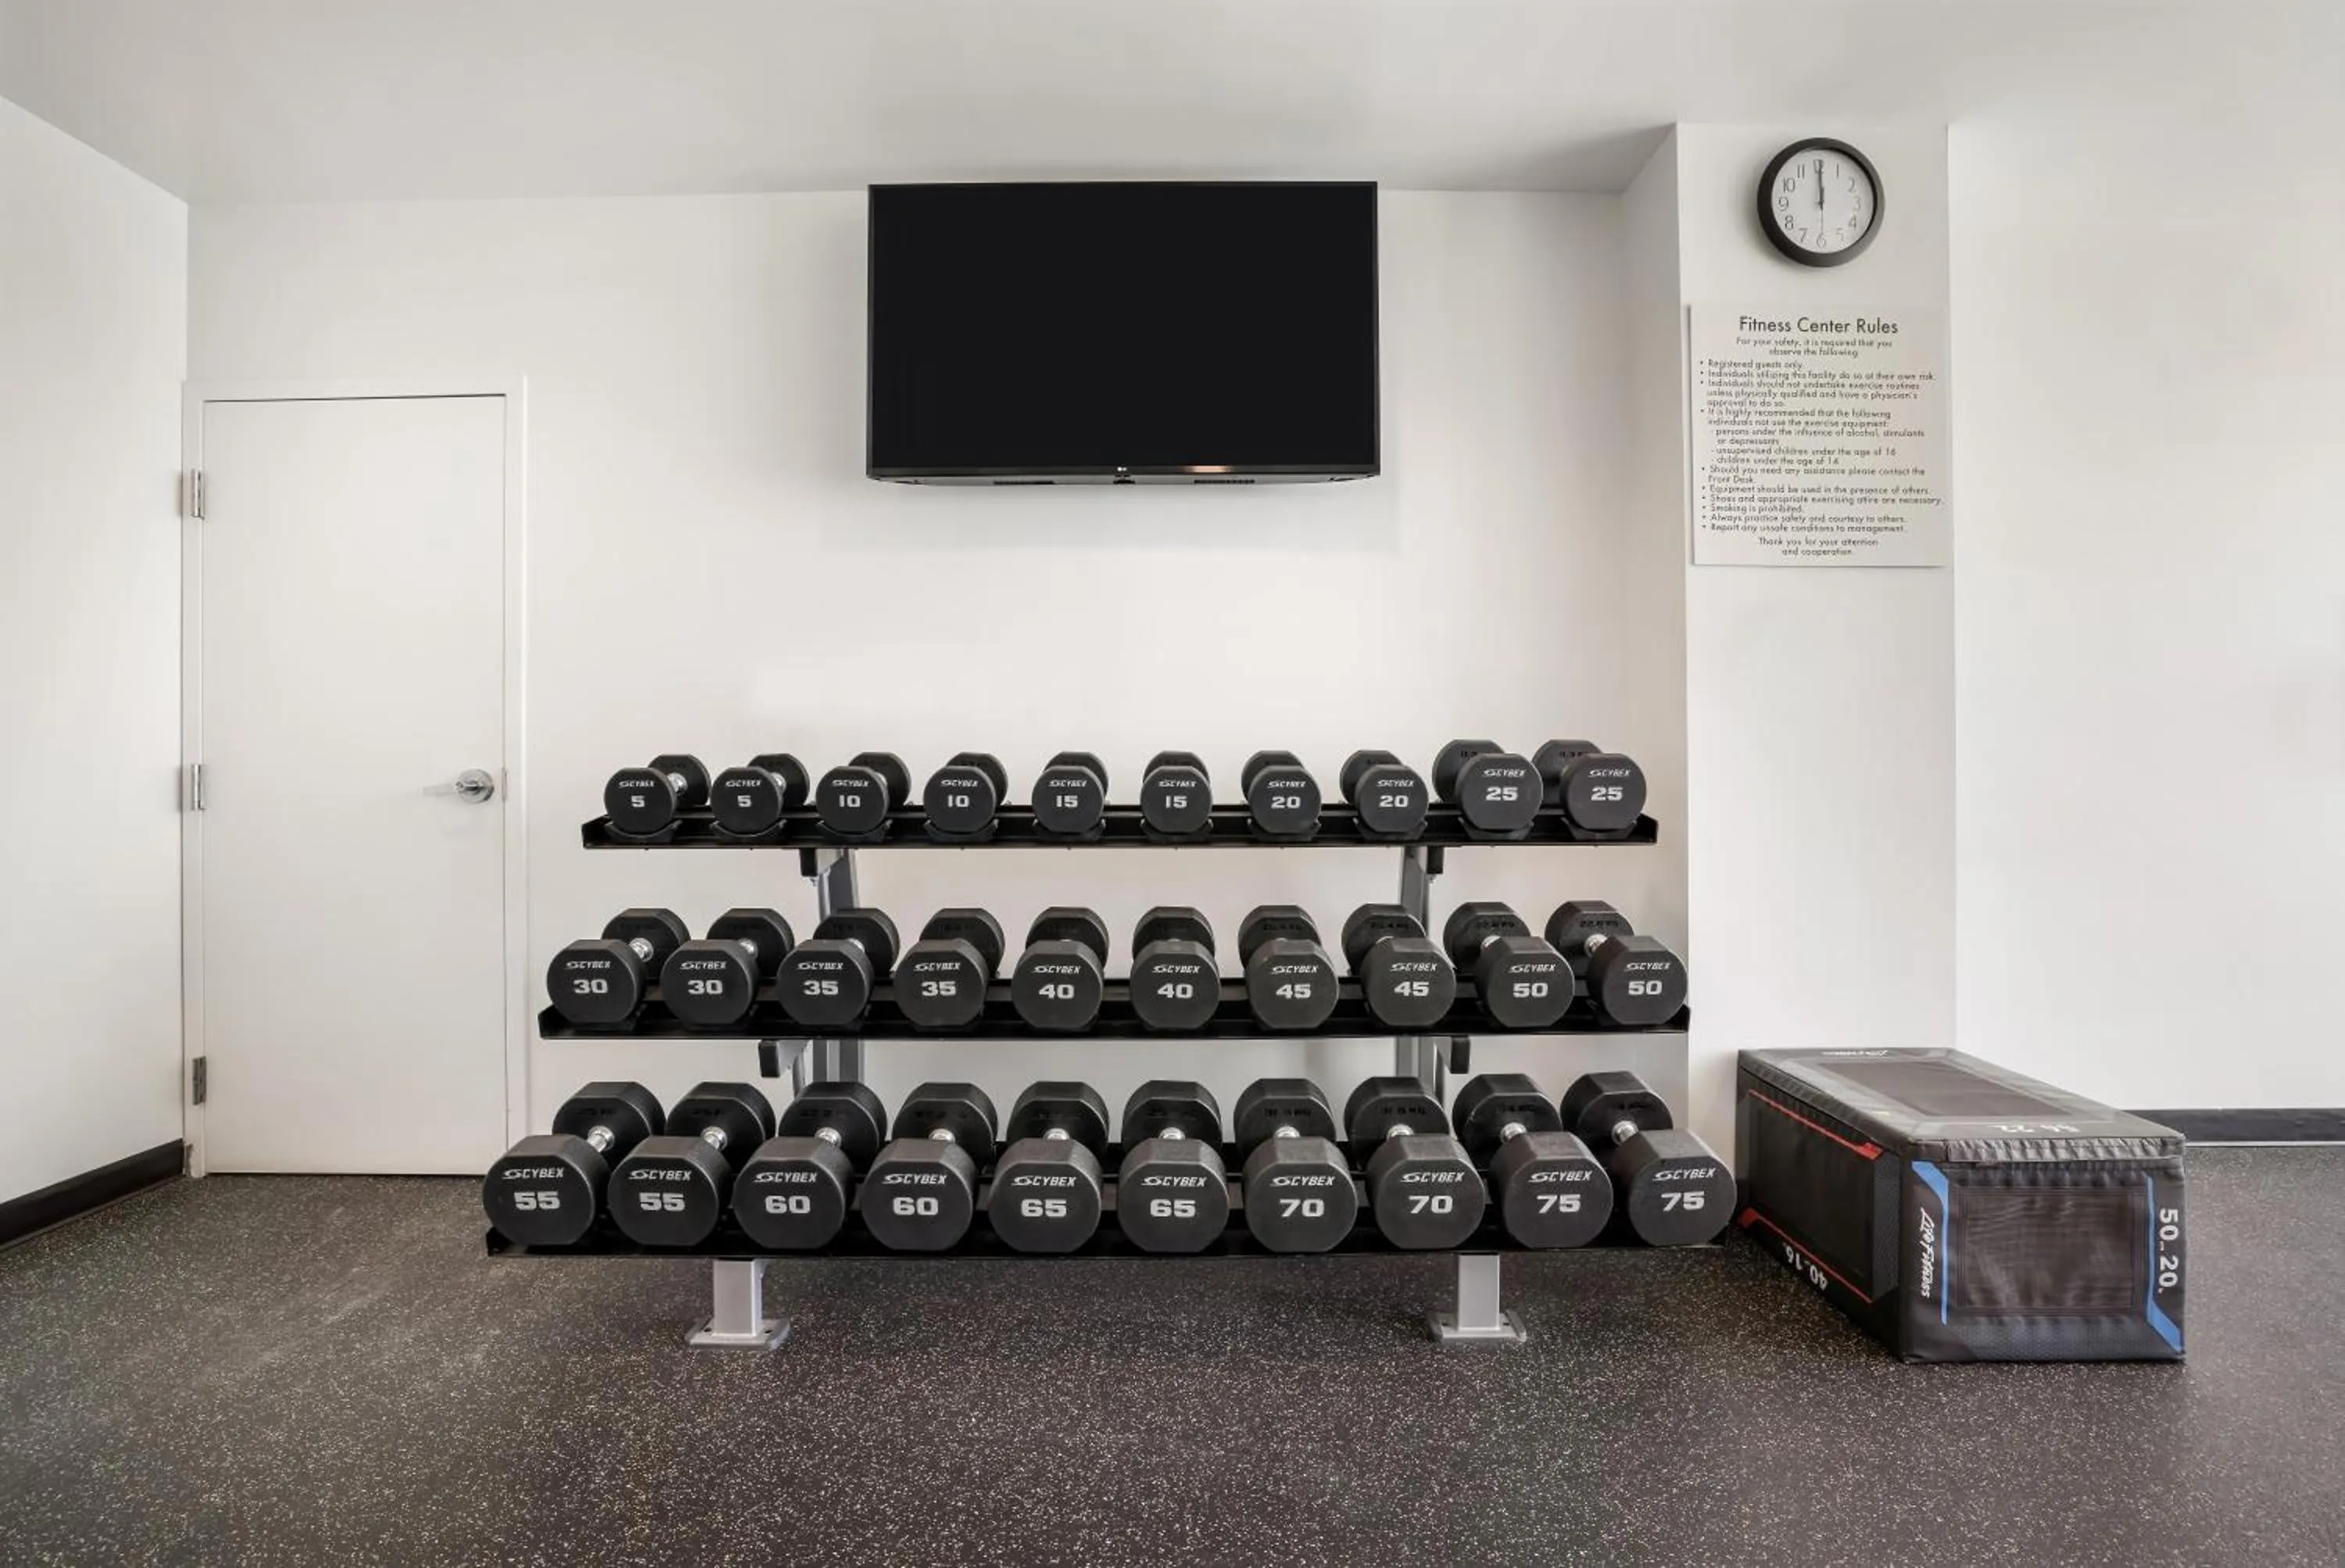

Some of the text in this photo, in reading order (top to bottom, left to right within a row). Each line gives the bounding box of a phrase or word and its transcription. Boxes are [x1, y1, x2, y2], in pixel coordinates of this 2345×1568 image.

[1797, 164, 1805, 179] 11
[1783, 177, 1795, 193] 10
[1848, 177, 1856, 192] 2
[1778, 197, 1789, 211] 9
[1853, 196, 1862, 211] 3
[1785, 216, 1794, 230] 8
[1849, 216, 1857, 229] 4
[1799, 228, 1809, 242] 7
[1817, 233, 1827, 248] 6
[1837, 228, 1845, 242] 5
[1739, 316, 1899, 334] Fitness Center Rules
[1770, 347, 1801, 356] observe
[1877, 341, 1892, 349] you
[1709, 359, 1753, 370] Registered
[1756, 360, 1781, 370] guests
[1808, 371, 1836, 380] facility
[1716, 429, 1749, 439] persons
[1774, 446, 1807, 455] children
[1811, 447, 1836, 456] under
[1838, 446, 1851, 456] the
[1854, 449, 1871, 458] age
[1710, 503, 1747, 514] Smoking
[1710, 514, 1742, 522] Always
[1781, 514, 1806, 523] safety
[1809, 514, 1825, 523] and
[1759, 537, 1783, 546] Thank
[1805, 537, 1817, 546] for
[1782, 546, 1799, 556] and
[839, 794, 861, 807] 10
[947, 794, 970, 807] 10
[1485, 786, 1519, 801] 25
[1590, 786, 1624, 801] 25
[631, 795, 645, 807] 5
[737, 795, 752, 807] 5
[1056, 795, 1078, 808] 15
[1165, 795, 1187, 809] 15
[1271, 796, 1301, 809] 20
[1378, 794, 1409, 808] 20
[693, 961, 726, 970] CYBEX
[926, 962, 961, 972] CYBEX
[1046, 965, 1081, 974] CYBEX
[1165, 964, 1201, 974] CYBEX
[1283, 965, 1319, 975] CYBEX
[1402, 962, 1437, 972] CYBEX
[1521, 964, 1556, 973] CYBEX
[1637, 962, 1670, 971] CYBEX
[573, 979, 608, 993] 30
[688, 979, 723, 995] 30
[804, 980, 839, 996] 35
[922, 981, 957, 997] 35
[1038, 983, 1075, 999] 40
[1157, 983, 1194, 999] 40
[1275, 983, 1312, 1000] 45
[1394, 981, 1430, 997] 45
[1513, 982, 1548, 998] 50
[1627, 979, 1663, 996] 50
[519, 1168, 564, 1180] CYBEX
[646, 1169, 691, 1180] CYBEX
[770, 1172, 817, 1183] CYBEX
[899, 1173, 947, 1185] CYBEX
[1028, 1175, 1076, 1187] CYBEX
[1288, 1175, 1336, 1187] CYBEX
[1416, 1172, 1465, 1183] CYBEX
[1545, 1170, 1592, 1183] CYBEX
[1668, 1167, 1717, 1181] CYBEX
[1158, 1176, 1207, 1187] CYBEX
[514, 1190, 560, 1210] 55
[639, 1192, 686, 1212] 55
[764, 1195, 811, 1214] 60
[893, 1197, 939, 1215] 60
[1409, 1195, 1453, 1214] 70
[1536, 1194, 1581, 1214] 75
[1660, 1190, 1705, 1212] 75
[1021, 1198, 1067, 1218] 65
[1150, 1198, 1196, 1218] 65
[1280, 1198, 1325, 1218] 70
